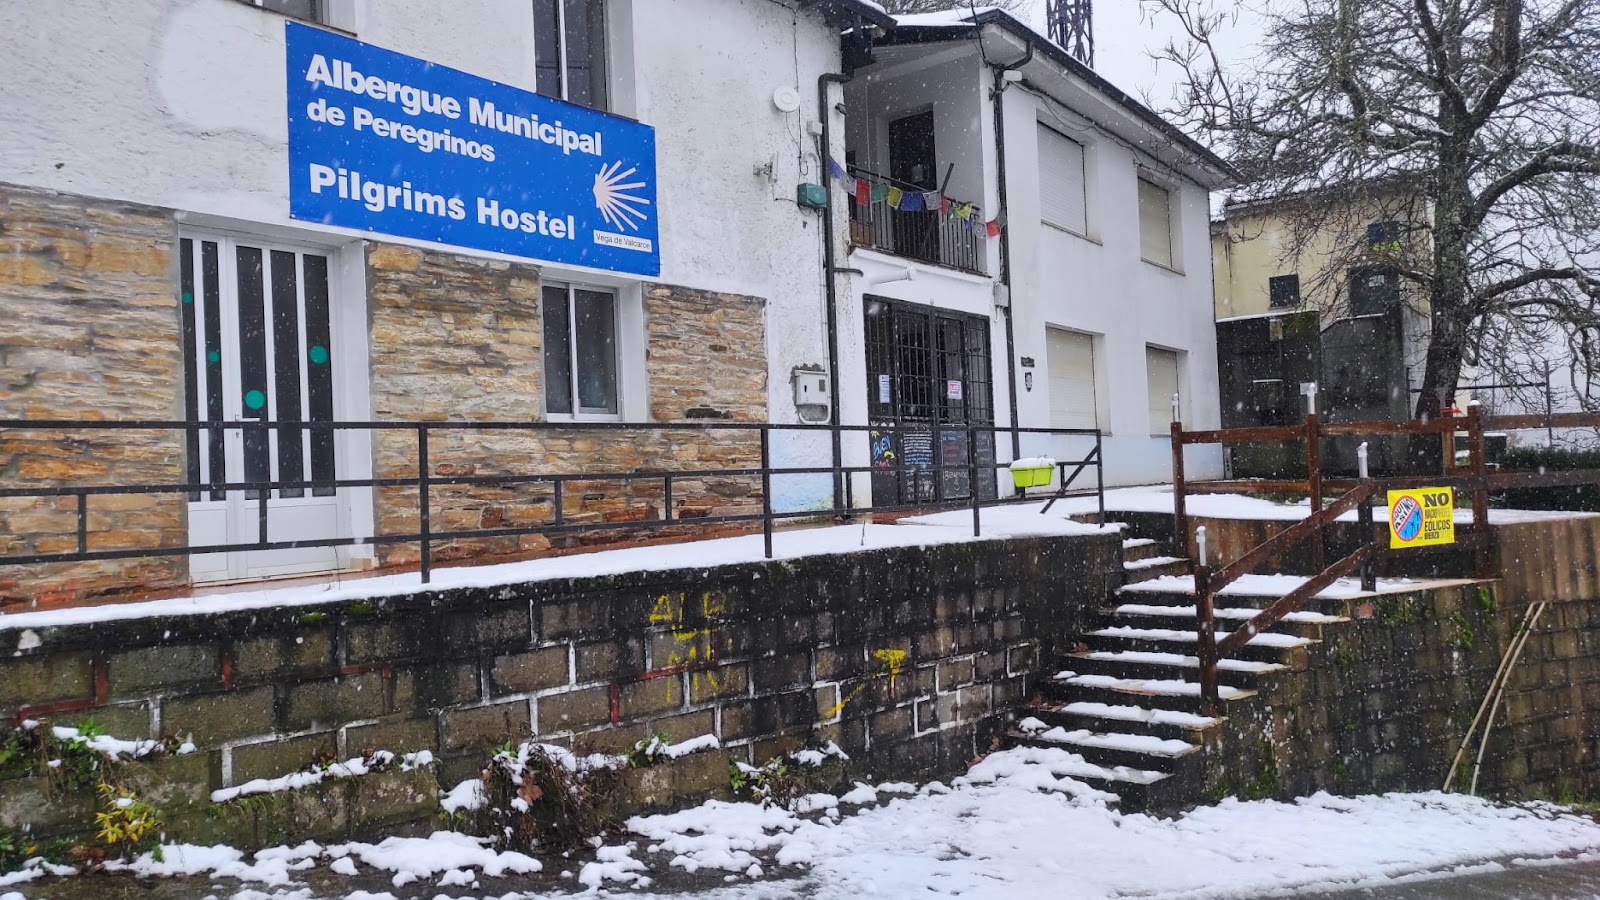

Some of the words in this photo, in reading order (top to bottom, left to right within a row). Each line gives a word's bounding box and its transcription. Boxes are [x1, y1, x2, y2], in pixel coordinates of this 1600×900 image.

[305, 53, 461, 119] Albergue
[468, 97, 602, 156] Municipal
[306, 98, 346, 126] de
[353, 106, 496, 162] Peregrinos
[309, 163, 466, 220] Pilgrims
[477, 197, 575, 240] Hostel
[596, 233, 613, 244] Vega
[614, 237, 623, 245] de
[623, 238, 651, 250] Valcarce
[1423, 493, 1449, 507] NO
